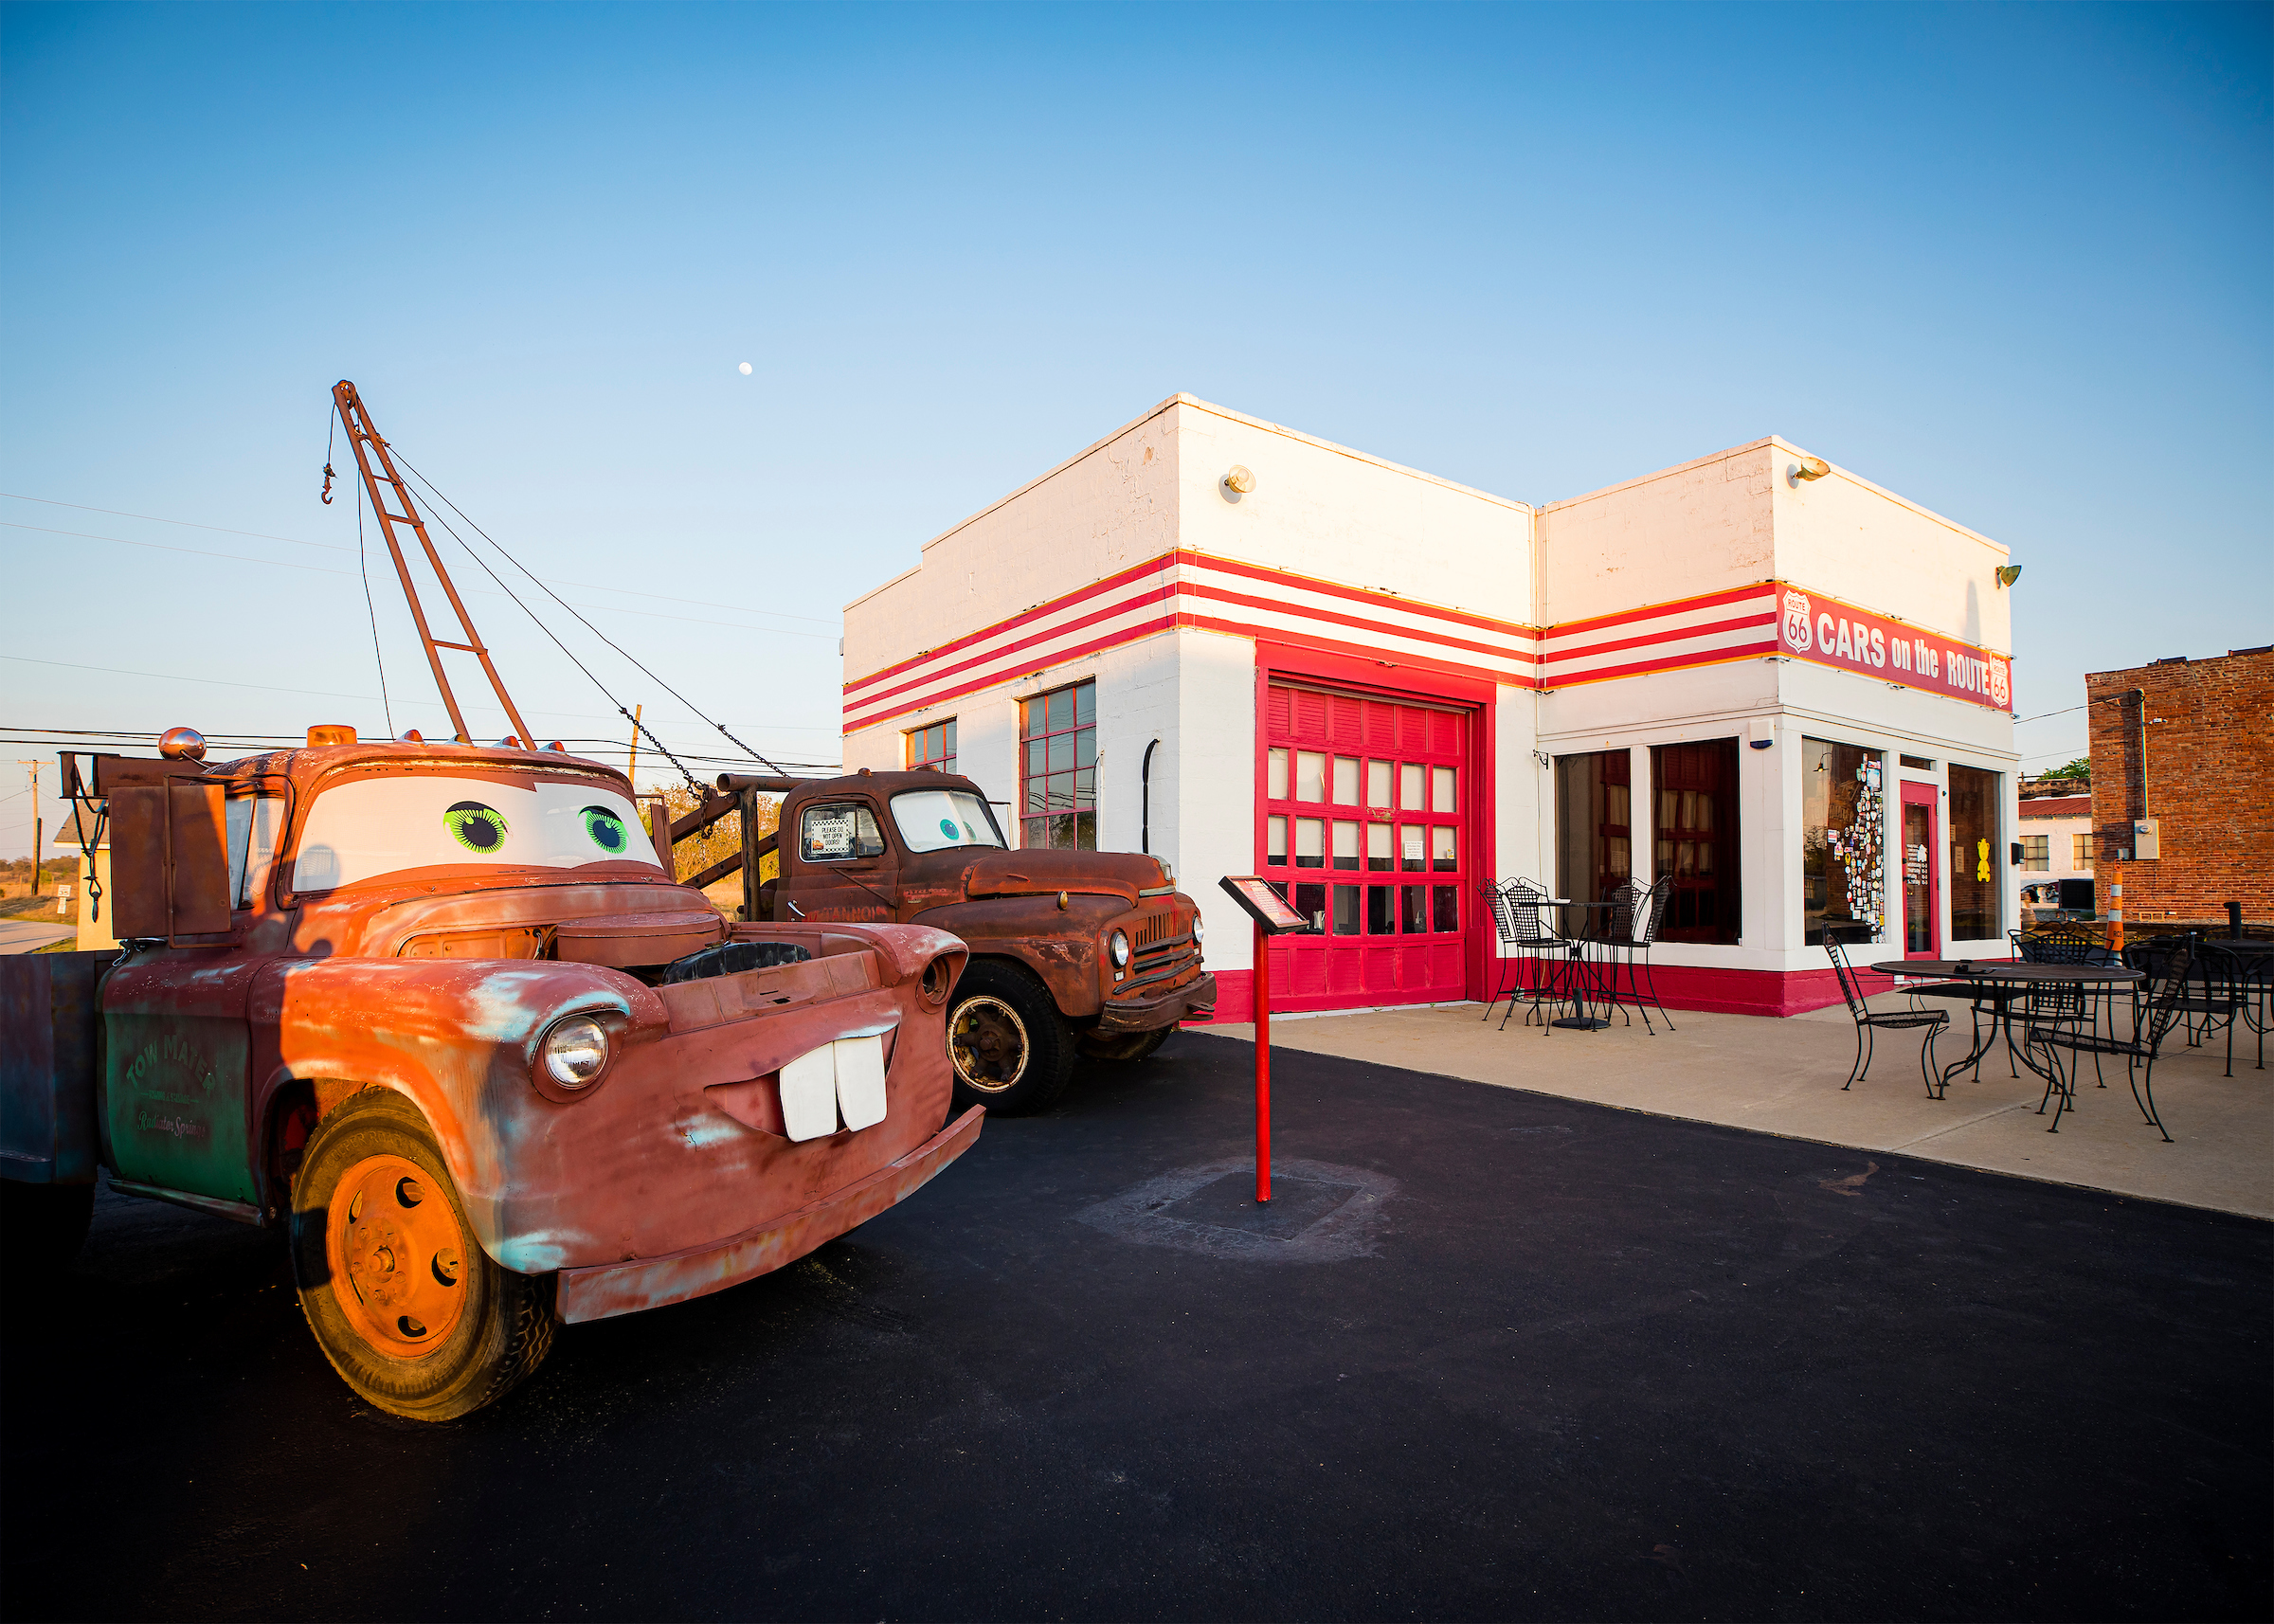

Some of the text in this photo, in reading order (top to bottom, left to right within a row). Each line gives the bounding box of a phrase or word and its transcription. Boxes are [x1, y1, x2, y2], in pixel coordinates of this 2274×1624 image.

[1788, 598, 1806, 612] ROUTE
[1788, 614, 1808, 643] 66
[1817, 613, 1991, 695] CARS on the ROUTE
[1994, 663, 2006, 676] ROUTE
[1994, 676, 2007, 699] 66
[126, 1035, 216, 1097] TOW MATER
[137, 1110, 206, 1141] Radiator Springs
